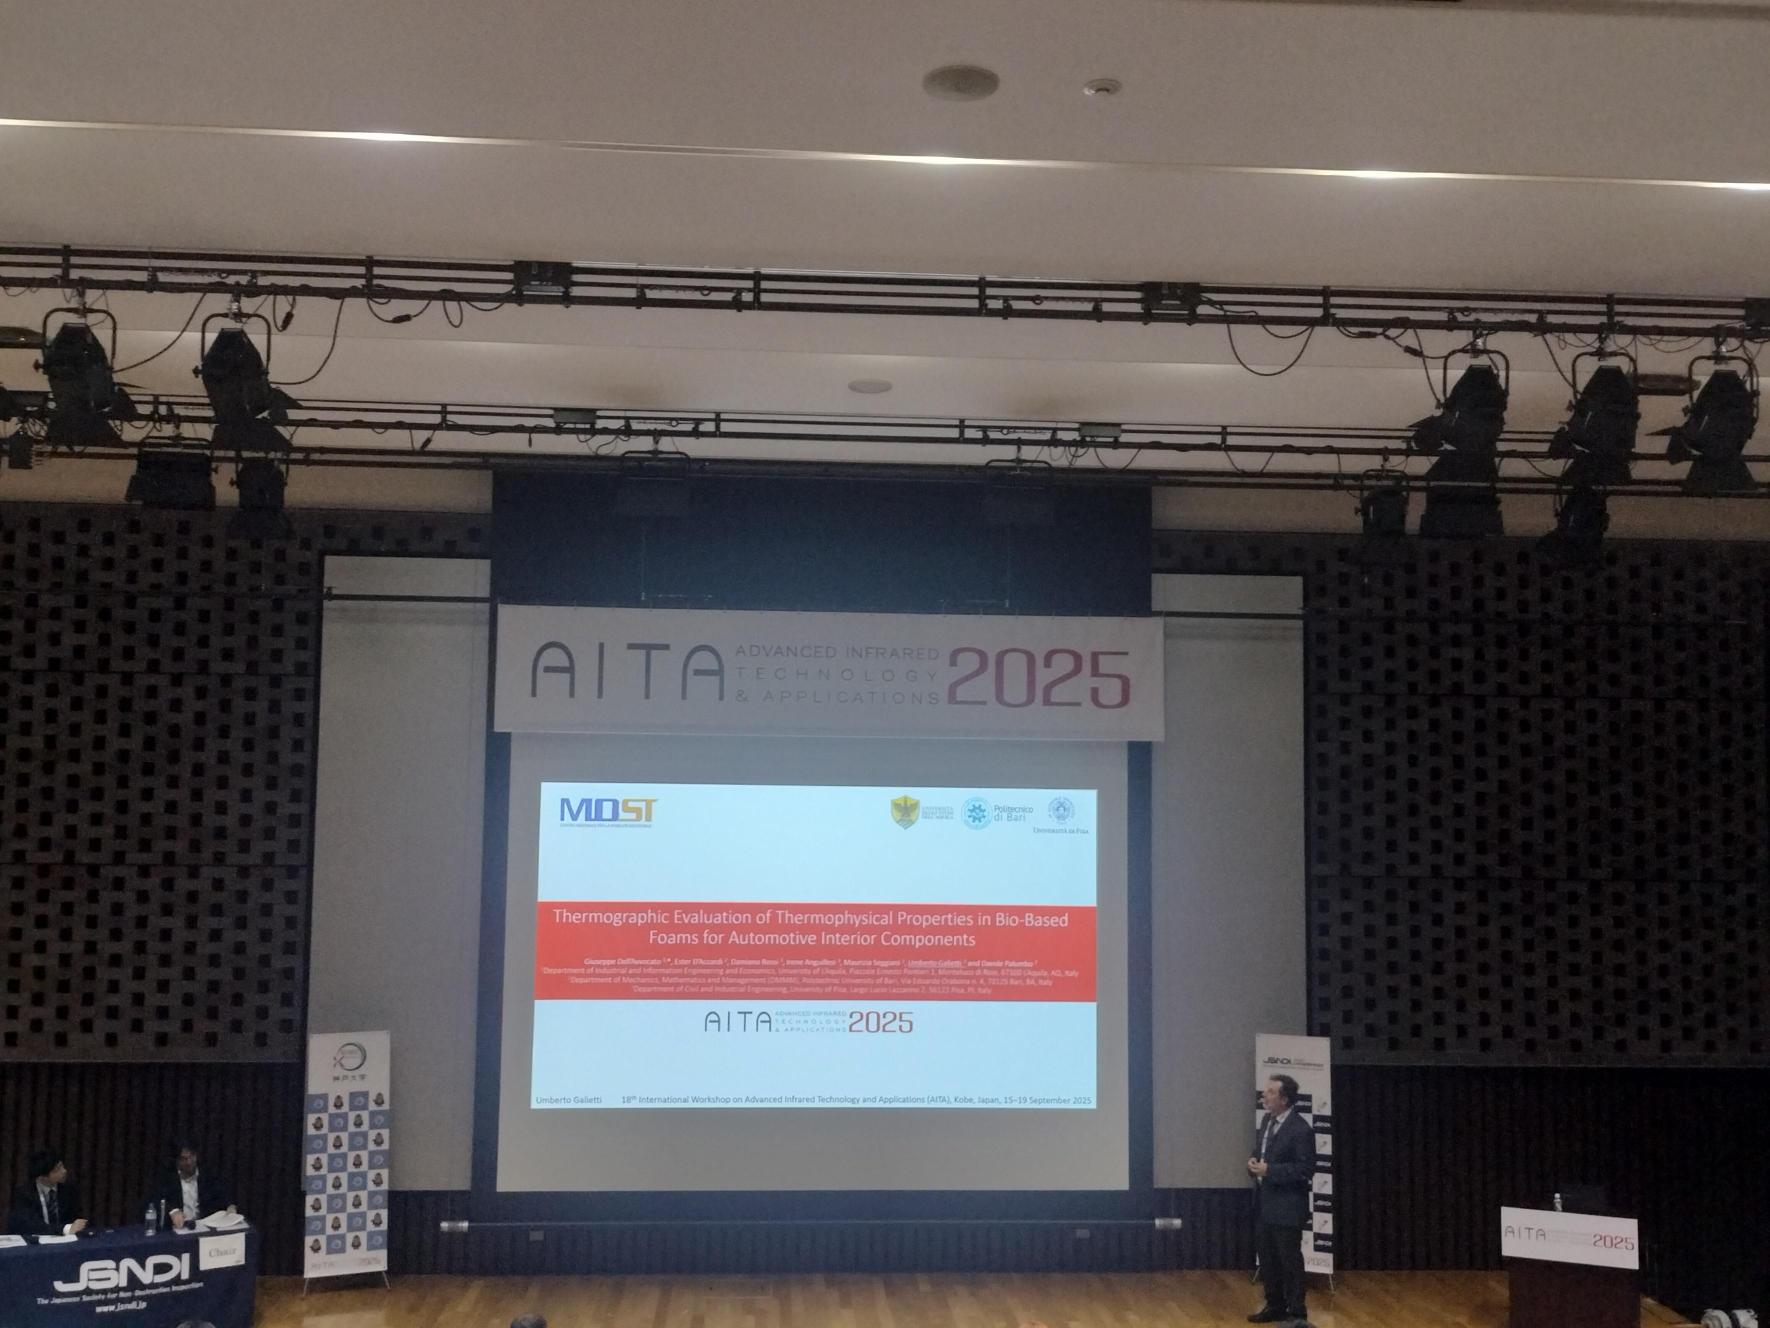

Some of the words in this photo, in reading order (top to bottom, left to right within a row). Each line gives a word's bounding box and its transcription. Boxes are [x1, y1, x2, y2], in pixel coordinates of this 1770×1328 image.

[735, 645, 837, 659] ADVANCED
[845, 646, 941, 661] INFRARED
[531, 641, 724, 701] AITA
[735, 666, 938, 682] TECHNOLOGY
[948, 646, 1131, 709] 2025
[735, 688, 749, 702] &
[762, 689, 940, 705] APPLICATIONS
[994, 804, 1034, 815] Politecnico
[994, 814, 1002, 822] di
[1006, 813, 1027, 822] Bari
[553, 908, 670, 927] Thermographic
[674, 909, 751, 924] Evaluation
[756, 909, 773, 924] of
[775, 910, 893, 928] Thermophysical
[897, 911, 974, 929] Properties
[978, 912, 991, 925] in
[995, 912, 1069, 927] Bio-Based
[649, 930, 699, 944] Foams
[703, 929, 725, 944] for
[728, 930, 817, 945] Automotive
[821, 931, 878, 945] Interior
[880, 931, 976, 949] Components
[704, 1011, 772, 1033] AITA
[848, 1011, 914, 1034] 2025
[535, 1096, 571, 1104] Umberto
[573, 1096, 602, 1104] Galietti
[638, 1096, 689, 1104] International
[690, 1096, 731, 1105] Workshop
[744, 1096, 783, 1104] Advanced
[785, 1096, 816, 1104] Infrared
[817, 1096, 861, 1105] Technology
[862, 1096, 877, 1104] and
[878, 1096, 926, 1105] Applications
[954, 1096, 976, 1105] Kobe,
[977, 1097, 1001, 1105] Japan,
[1028, 1096, 1070, 1105] September
[1504, 1226, 1546, 1241] AITA
[1593, 1233, 1636, 1251] 2025
[53, 1252, 190, 1293] JSNDI
[36, 1297, 50, 1305] The
